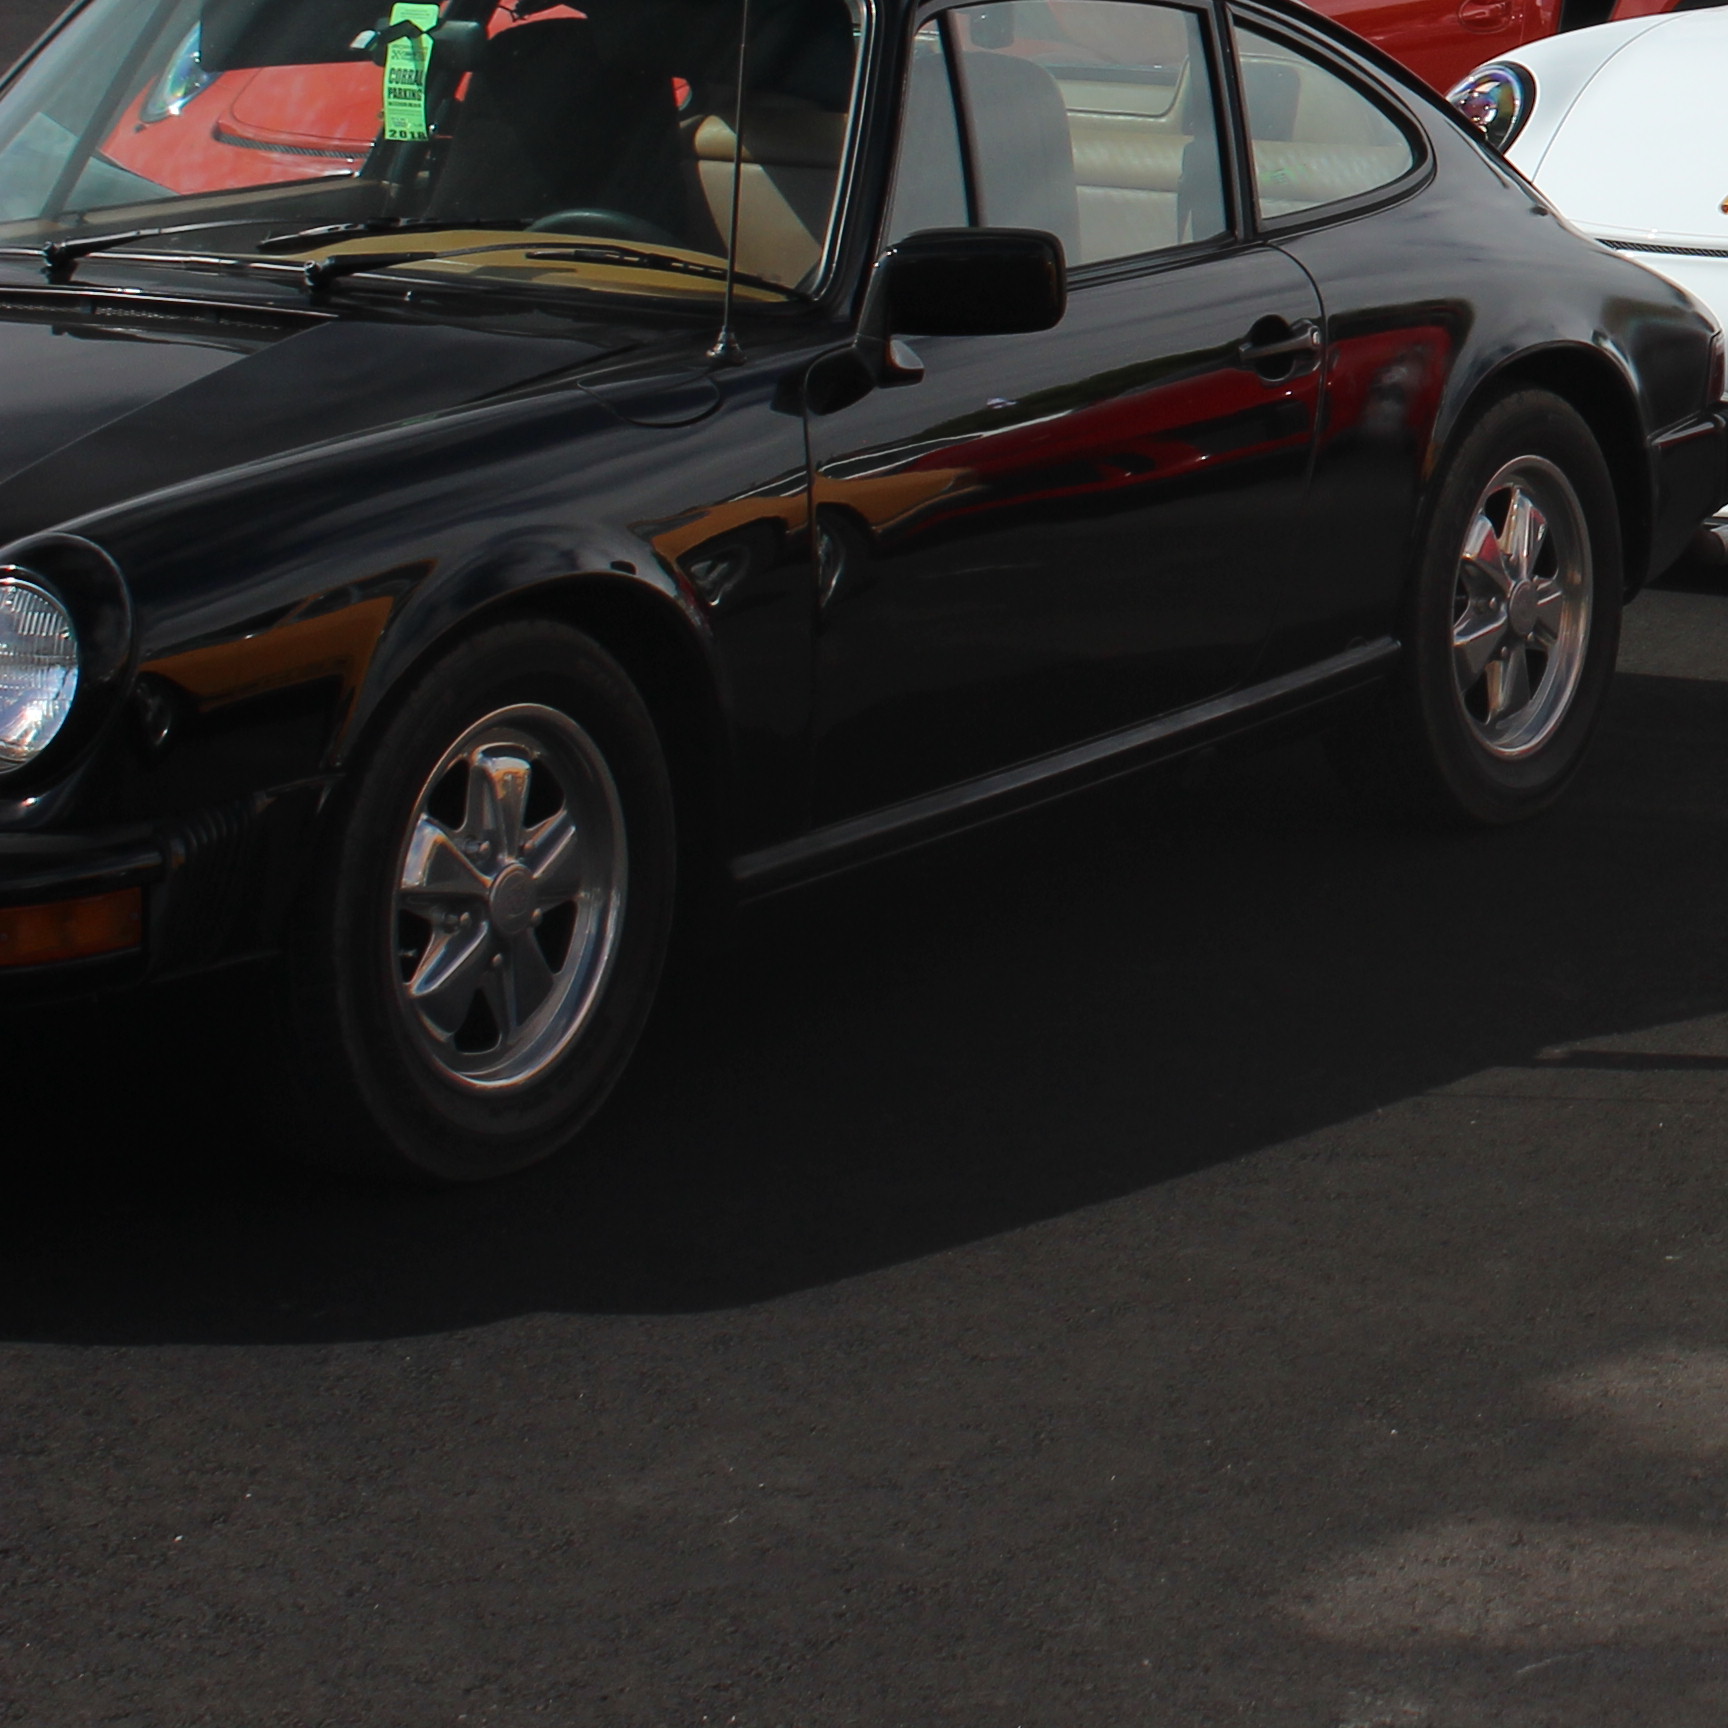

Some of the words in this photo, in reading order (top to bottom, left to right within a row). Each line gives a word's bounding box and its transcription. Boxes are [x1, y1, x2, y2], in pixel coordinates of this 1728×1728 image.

[388, 67, 423, 86] CORRAL
[388, 87, 422, 101] PARKING
[388, 129, 429, 140] 2018
